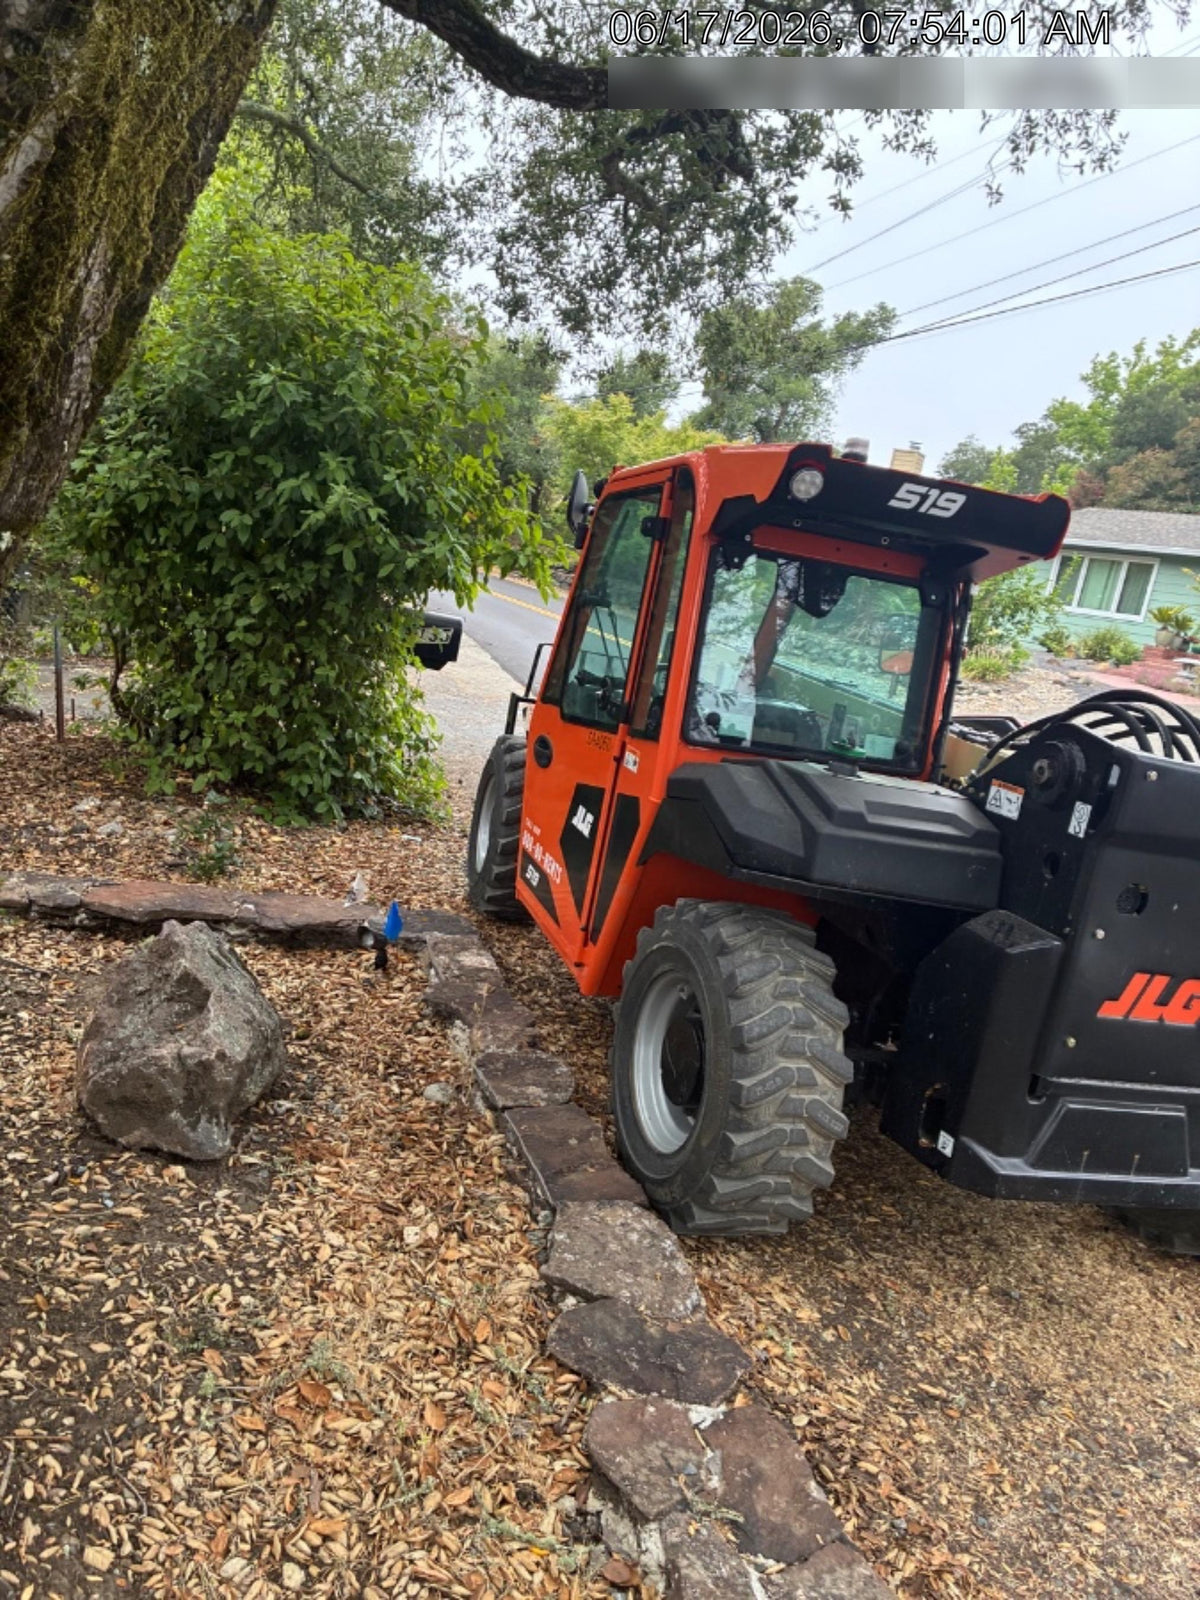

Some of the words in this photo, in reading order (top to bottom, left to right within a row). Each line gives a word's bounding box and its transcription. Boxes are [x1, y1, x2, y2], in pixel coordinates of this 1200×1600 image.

[887, 482, 967, 518] 519
[571, 804, 595, 839] JLG
[1096, 972, 1200, 1027] JLG
